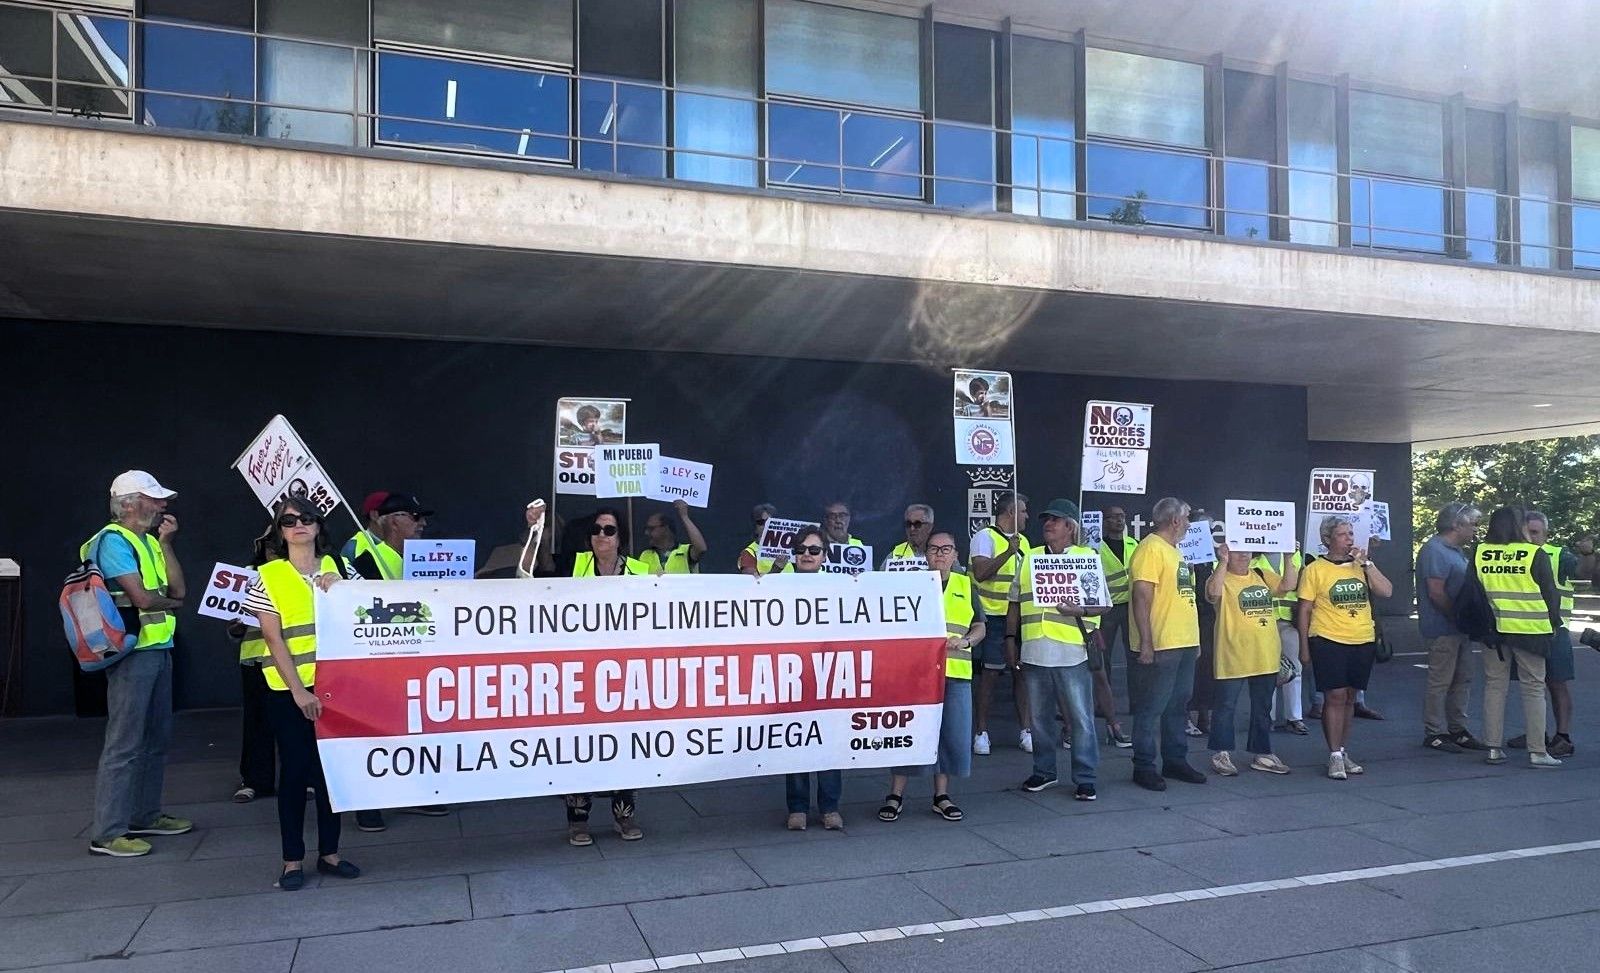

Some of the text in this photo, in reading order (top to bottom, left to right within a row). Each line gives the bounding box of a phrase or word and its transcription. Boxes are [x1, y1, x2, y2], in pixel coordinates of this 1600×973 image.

[1091, 406, 1134, 426] NO
[1089, 426, 1145, 437] OLORES
[603, 449, 652, 461] MI PUEBLO
[609, 463, 646, 478] QUIERE
[672, 467, 691, 478] LEY
[694, 471, 706, 481] se
[616, 481, 642, 494] VIDA
[1313, 479, 1349, 495] NO
[1238, 507, 1262, 516] Esto
[1312, 502, 1359, 511] BIOGAS
[762, 530, 797, 549] NO
[1245, 536, 1265, 544] mal
[412, 554, 426, 562] La
[428, 552, 454, 562] LEY
[1482, 550, 1528, 561] STOP
[412, 568, 457, 579] cumple
[1481, 566, 1526, 574] OLORES
[1035, 572, 1077, 585] STOP
[1036, 586, 1079, 595] OLORES
[1243, 589, 1268, 598] STOP
[1336, 583, 1363, 592] STOP
[454, 596, 922, 636] POR INCUMPLIMIENTO DE LA LEY
[407, 650, 873, 733] ¡CIERRE CAUTELAR YA!
[851, 710, 914, 730] STOP
[367, 720, 823, 778] CON LA SALUD NO SE JUEGA
